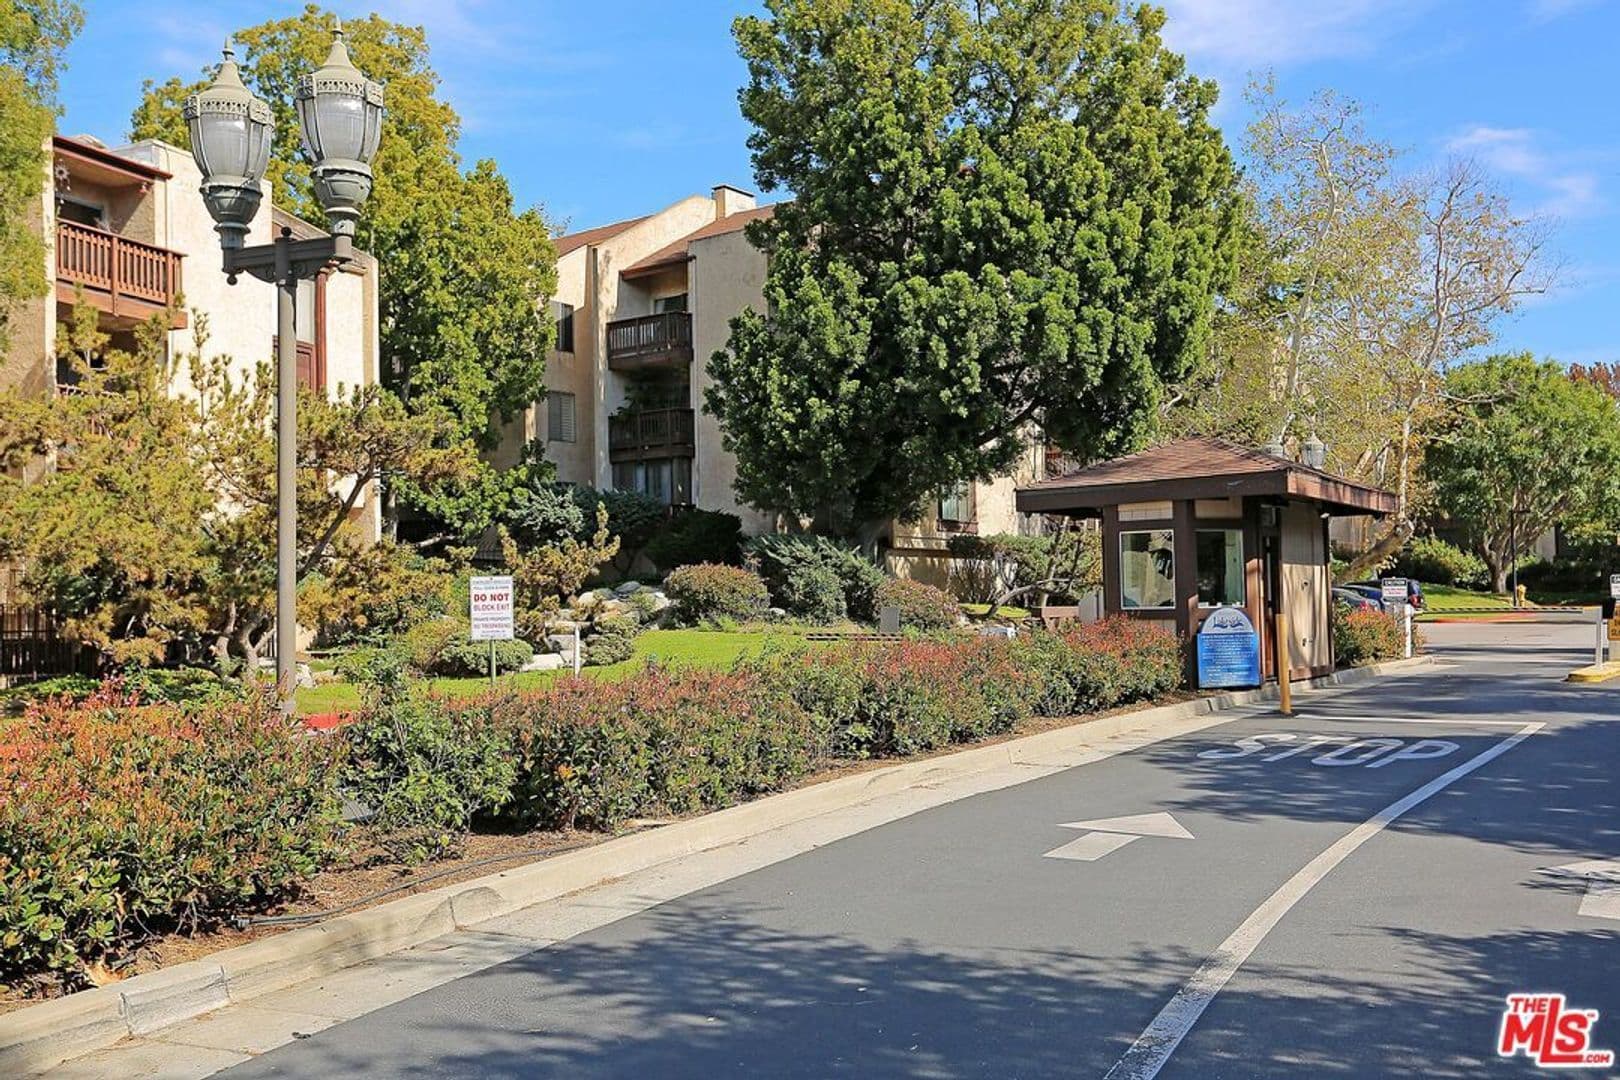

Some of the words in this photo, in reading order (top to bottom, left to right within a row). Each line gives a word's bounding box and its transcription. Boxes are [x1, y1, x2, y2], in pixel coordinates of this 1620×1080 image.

[474, 594, 487, 602] DO
[490, 593, 509, 602] NOT
[473, 604, 495, 612] BLOCK
[496, 603, 510, 611] EXIT
[1197, 733, 1460, 768] STOP
